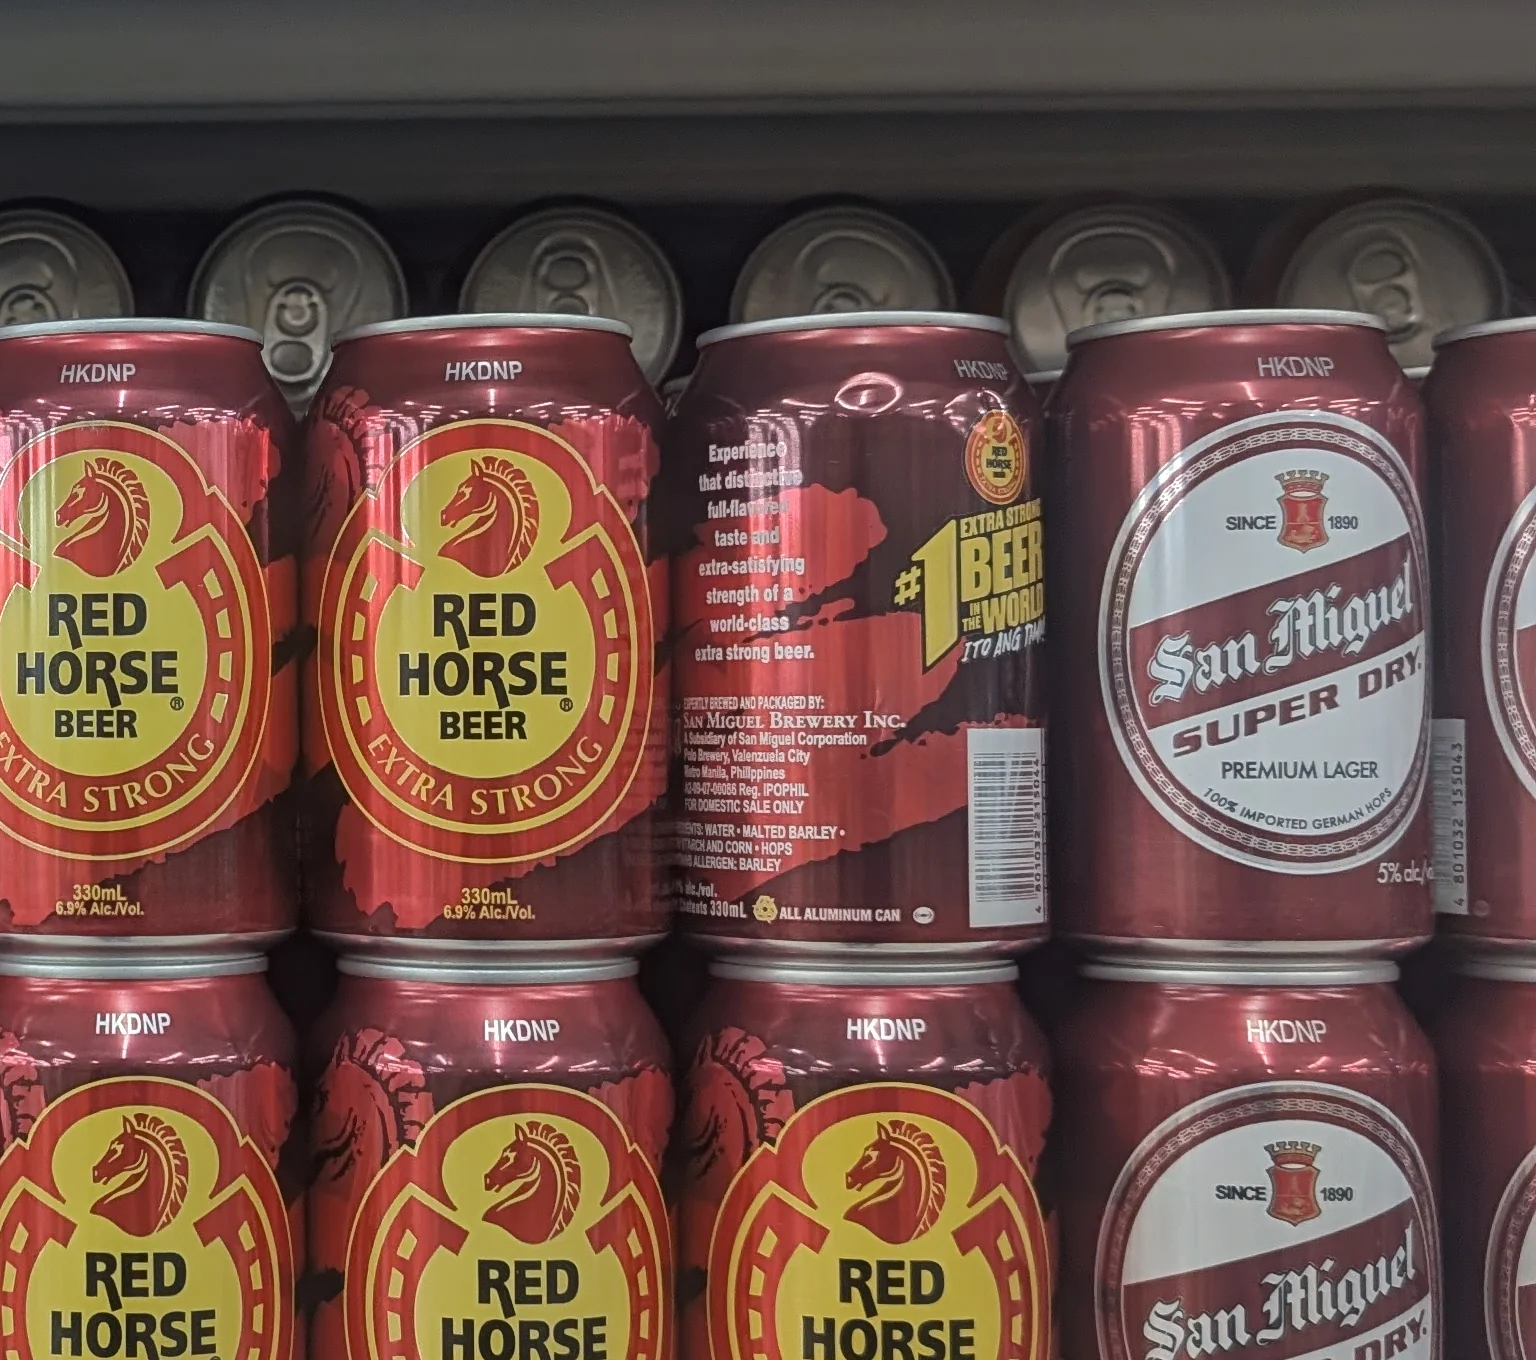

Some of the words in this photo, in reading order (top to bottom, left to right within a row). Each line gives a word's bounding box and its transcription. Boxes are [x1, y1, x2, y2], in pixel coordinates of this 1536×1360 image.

[60, 363, 136, 384] HKDNP
[1257, 356, 1334, 378] HKDNP
[708, 441, 787, 465] Experience
[699, 475, 722, 492] that
[1225, 515, 1276, 531] SINCE
[1328, 515, 1359, 530] 1890
[715, 530, 747, 547] taste
[752, 526, 779, 544] and
[699, 555, 805, 576] extra-satisfying
[706, 584, 759, 606] strength
[764, 584, 778, 601] of
[783, 587, 793, 601] a
[48, 593, 148, 650] RED
[710, 614, 790, 633] world-class
[1147, 630, 1262, 706] San
[1262, 554, 1416, 676] Miguel
[695, 644, 723, 662] extra
[726, 643, 770, 663] strong
[774, 642, 815, 660] beer.
[17, 650, 179, 708] HORSE
[53, 709, 138, 739] BEER
[769, 712, 857, 729] BREWERY
[863, 710, 906, 729] INC.
[1171, 684, 1340, 758] SUPER
[84, 734, 216, 814] STRONG
[1221, 759, 1319, 781] PREMIUM
[1322, 760, 1379, 780] LAGER
[1203, 786, 1238, 814] 100%
[1239, 806, 1308, 831] IMPORTED
[1311, 806, 1364, 830] GERMAN
[1364, 786, 1393, 816] HOPS
[779, 907, 801, 921] ALL
[804, 908, 872, 922] ALUMINUM
[875, 909, 900, 922] CAN
[95, 1012, 171, 1035] HKDNP
[846, 1018, 927, 1041] HKDNP
[839, 1258, 945, 1317] RED
[1255, 1226, 1416, 1348] Miguel
